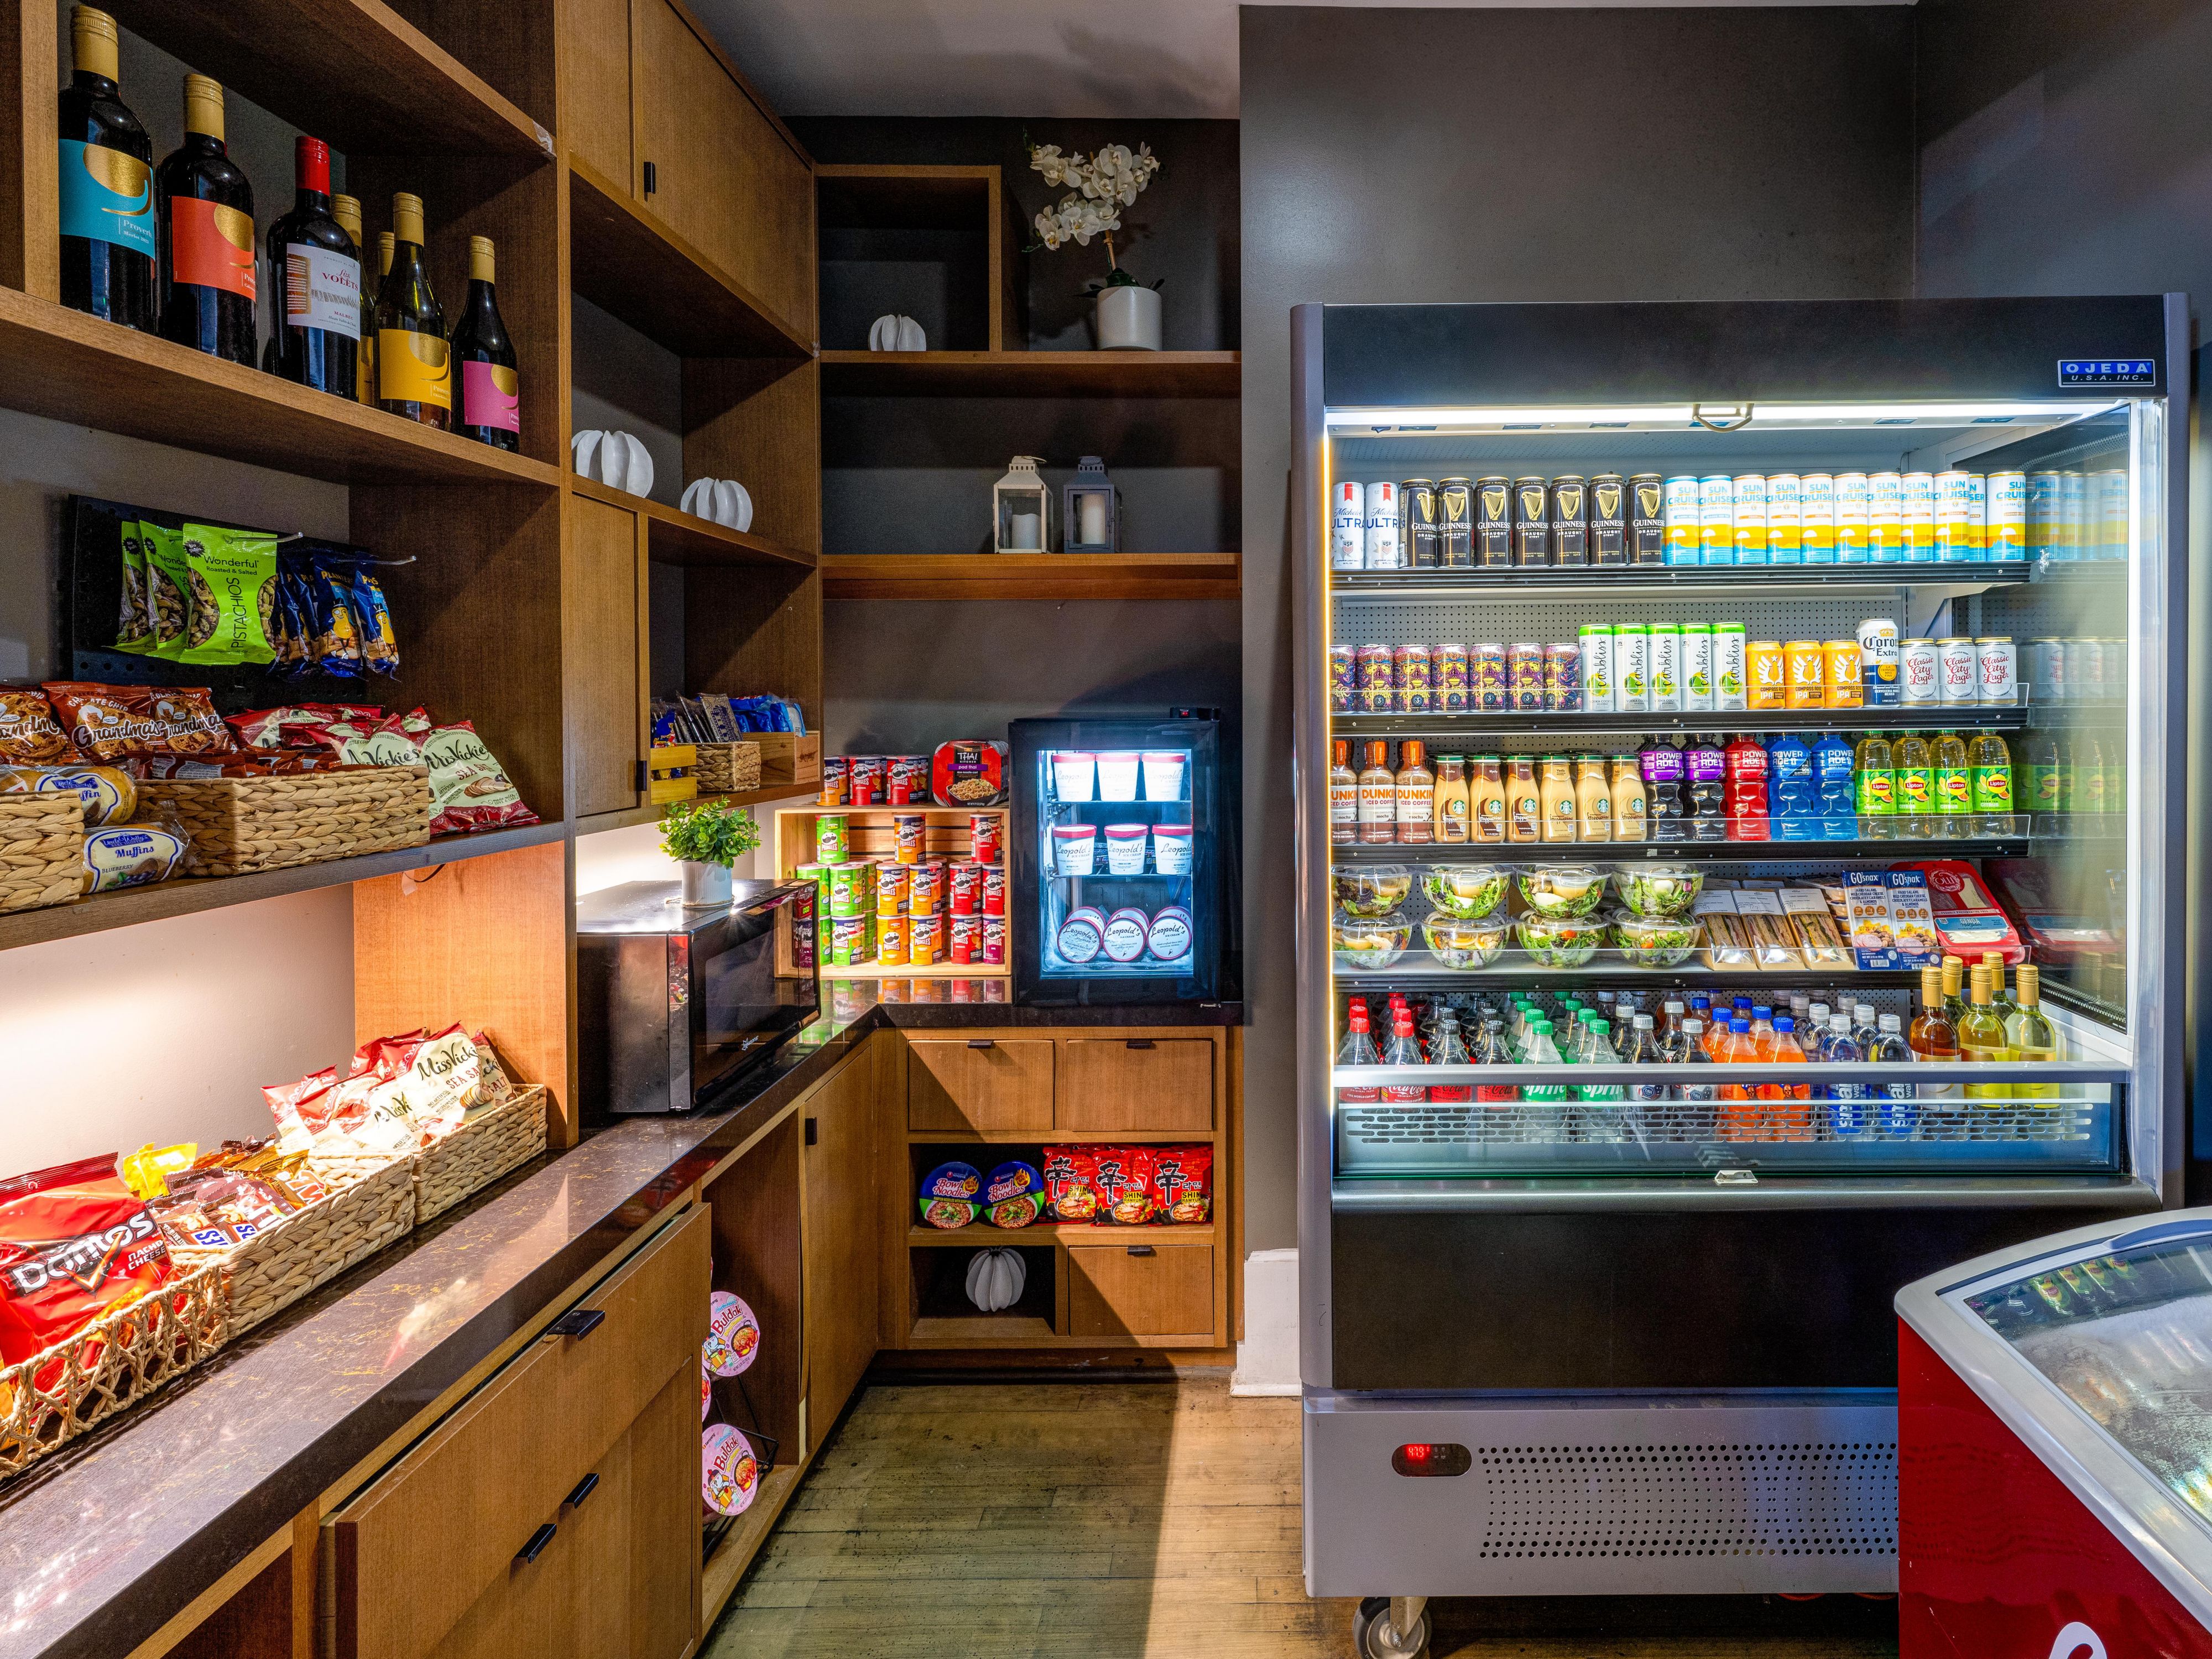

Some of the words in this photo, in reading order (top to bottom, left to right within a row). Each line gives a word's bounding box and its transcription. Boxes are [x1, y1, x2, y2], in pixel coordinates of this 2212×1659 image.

[322, 272, 358, 291] VOLETS
[334, 311, 353, 320] MALBEC
[2066, 363, 2148, 373] OJEDA
[1332, 518, 1364, 529] ULTRA
[1439, 523, 1472, 531] GUINNESS
[1478, 521, 1510, 530] GUINNESS
[1592, 520, 1624, 528] GUINNESS
[1633, 519, 1665, 528] GUINNESS
[204, 555, 258, 568] Wonderful
[226, 577, 247, 649] PISTACHIOS
[1876, 649, 1897, 657] Extra
[1906, 656, 1934, 667] Classic
[1944, 656, 1972, 666] Classic
[1980, 655, 2010, 666] Classic
[1911, 665, 1932, 675] City
[1949, 664, 1970, 674] City
[1985, 664, 2007, 675] City
[1910, 673, 1935, 685] Lager
[1948, 672, 1973, 684] Lager
[1983, 672, 2010, 684] Lager
[108, 700, 128, 711] CHIP
[72, 719, 159, 749] Grandma's
[957, 753, 978, 761] THAI
[456, 766, 478, 780] SEA
[853, 778, 869, 786] PRINGLES
[891, 778, 908, 786] PRINGLES
[103, 837, 119, 846] Uncle
[899, 839, 916, 847] PRINGLES
[115, 846, 154, 858] Muffins
[1057, 844, 1091, 857] Leopold's
[1108, 842, 1143, 856] Leopold's
[101, 864, 133, 874] BLUEBERRY
[880, 888, 896, 896] PRINGLES
[915, 888, 931, 896] PRINGLES
[1063, 925, 1098, 943] Leopold's
[1107, 926, 1140, 937] Leopold's
[1151, 925, 1186, 938] Leopold's
[884, 943, 900, 951] PRINGLES
[915, 937, 931, 946] PRINGLES
[446, 1076, 465, 1089] SEA
[1045, 1156, 1077, 1198] 辛
[1070, 1176, 1089, 1184] 라면
[1155, 1160, 1188, 1205] 辛
[937, 1178, 963, 1188] Bowl
[988, 1179, 1014, 1193] Bowl
[1096, 1160, 1128, 1206] 辛
[1123, 1182, 1142, 1191] 라면
[1182, 1181, 1202, 1191] 라면
[932, 1187, 970, 1198] Noodles
[988, 1185, 1025, 1202] Noodles
[128, 1249, 166, 1271] CHEESE
[711, 1305, 742, 1335] Buldak
[713, 1436, 738, 1472] Buldak
